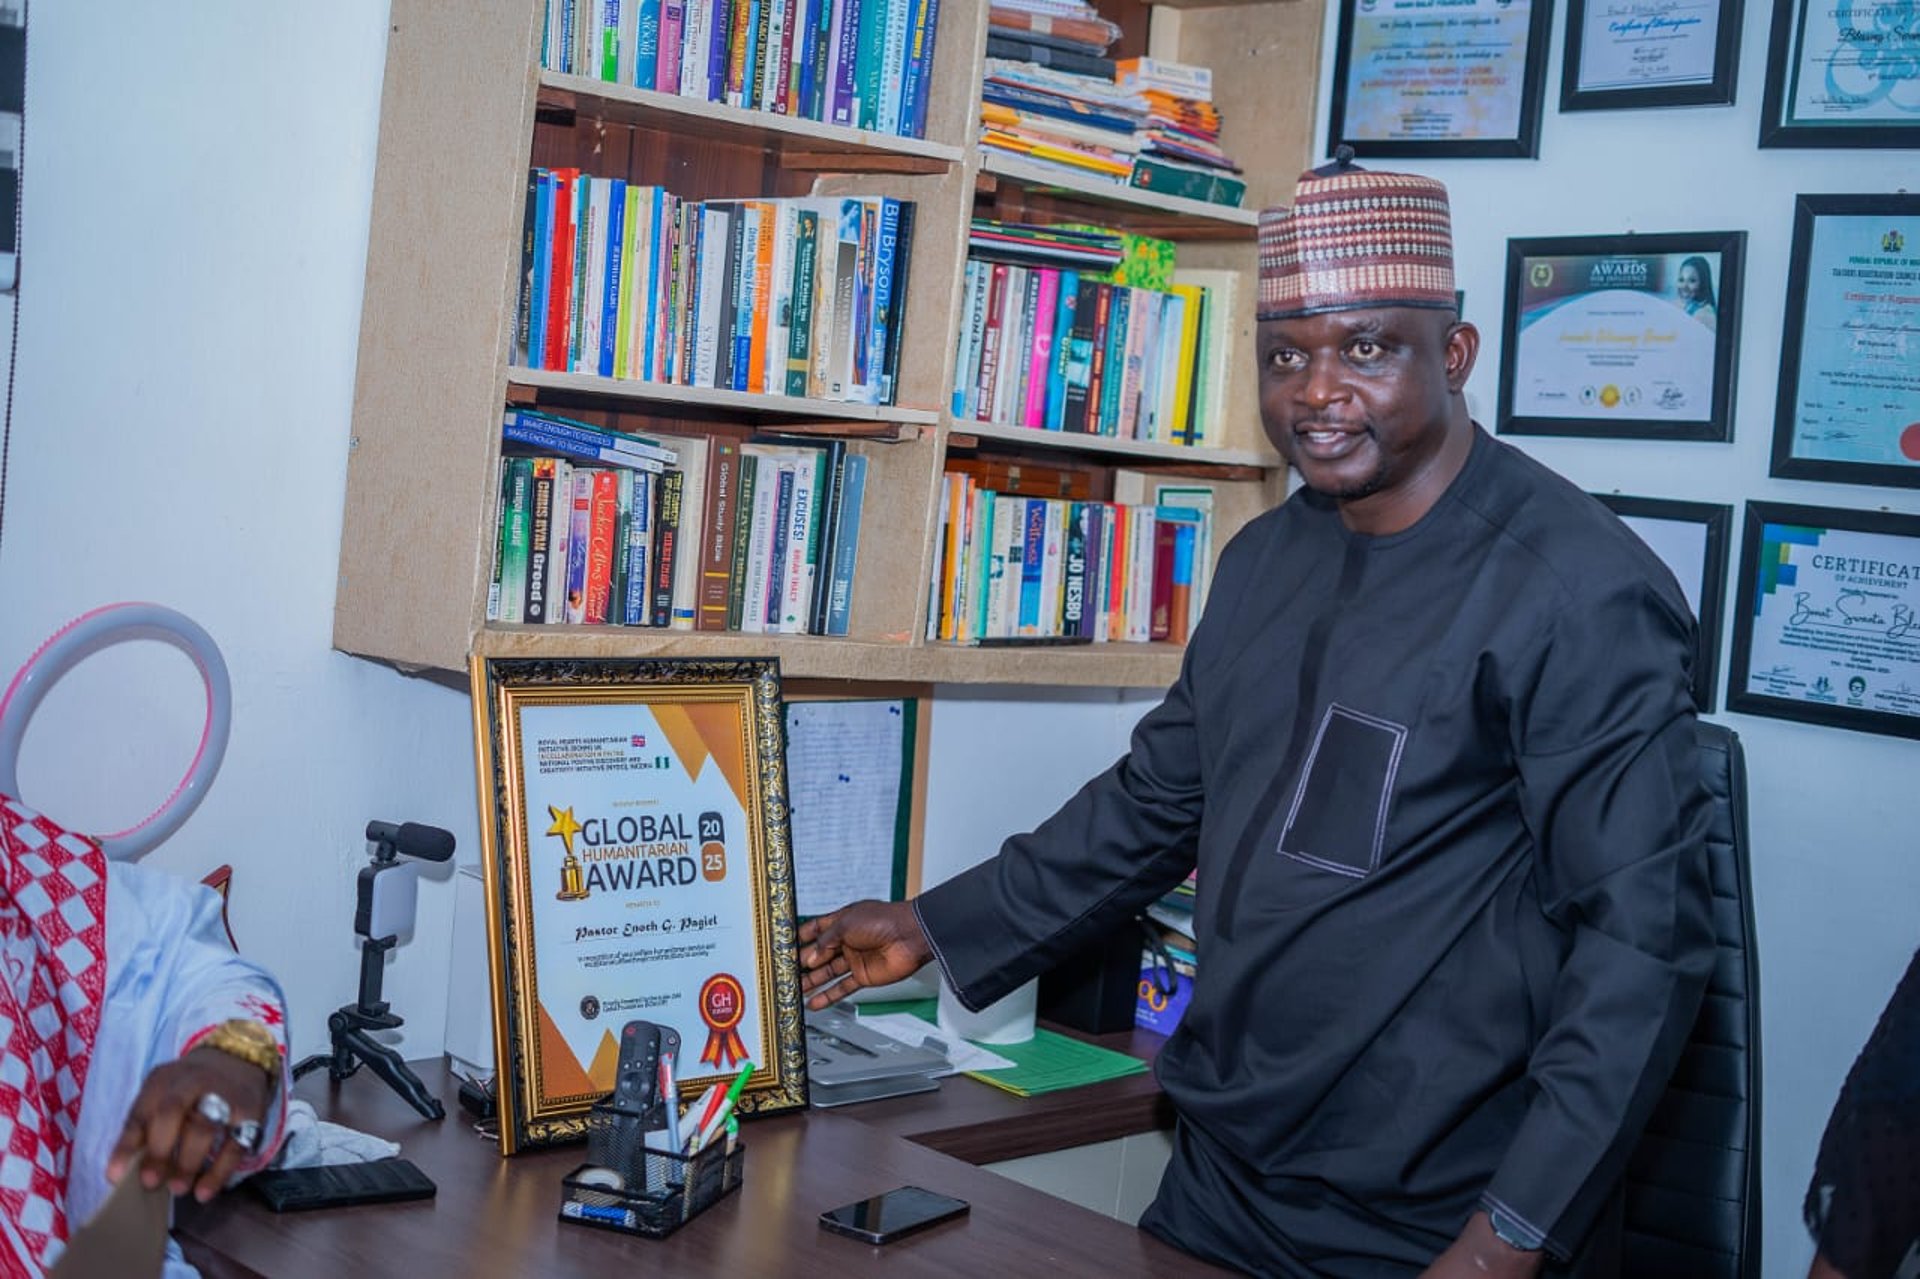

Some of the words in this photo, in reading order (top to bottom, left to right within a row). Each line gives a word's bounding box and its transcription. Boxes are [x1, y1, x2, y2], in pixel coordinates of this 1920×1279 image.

[884, 203, 900, 232] Bill
[876, 235, 896, 300] Bryson
[1592, 262, 1647, 275] AWARDS
[1028, 276, 1039, 323] BRADLEY
[719, 462, 729, 498] Global
[536, 480, 550, 518] CHRIS
[596, 492, 615, 533] Jackie
[717, 500, 726, 532] Study
[792, 489, 808, 541] EXCUSES!
[533, 520, 548, 551] RYAN
[715, 534, 723, 562] Bible
[591, 536, 608, 581] Collins
[1069, 553, 1085, 574] JO
[1812, 555, 1920, 579] CERTIFICAT
[531, 553, 545, 601] Greed
[1848, 575, 1908, 588] ACHIEVEMENT
[540, 759, 570, 767] NATIONAL
[581, 813, 693, 847] GLOBAL
[702, 818, 720, 838] 20
[582, 841, 690, 862] HUMANITARIAN
[705, 852, 723, 872] 25
[585, 856, 698, 892] AWARD
[576, 926, 619, 942] Pastor
[622, 920, 658, 937] Enoch
[680, 914, 718, 932] Pagiel
[711, 993, 731, 1008] GH
